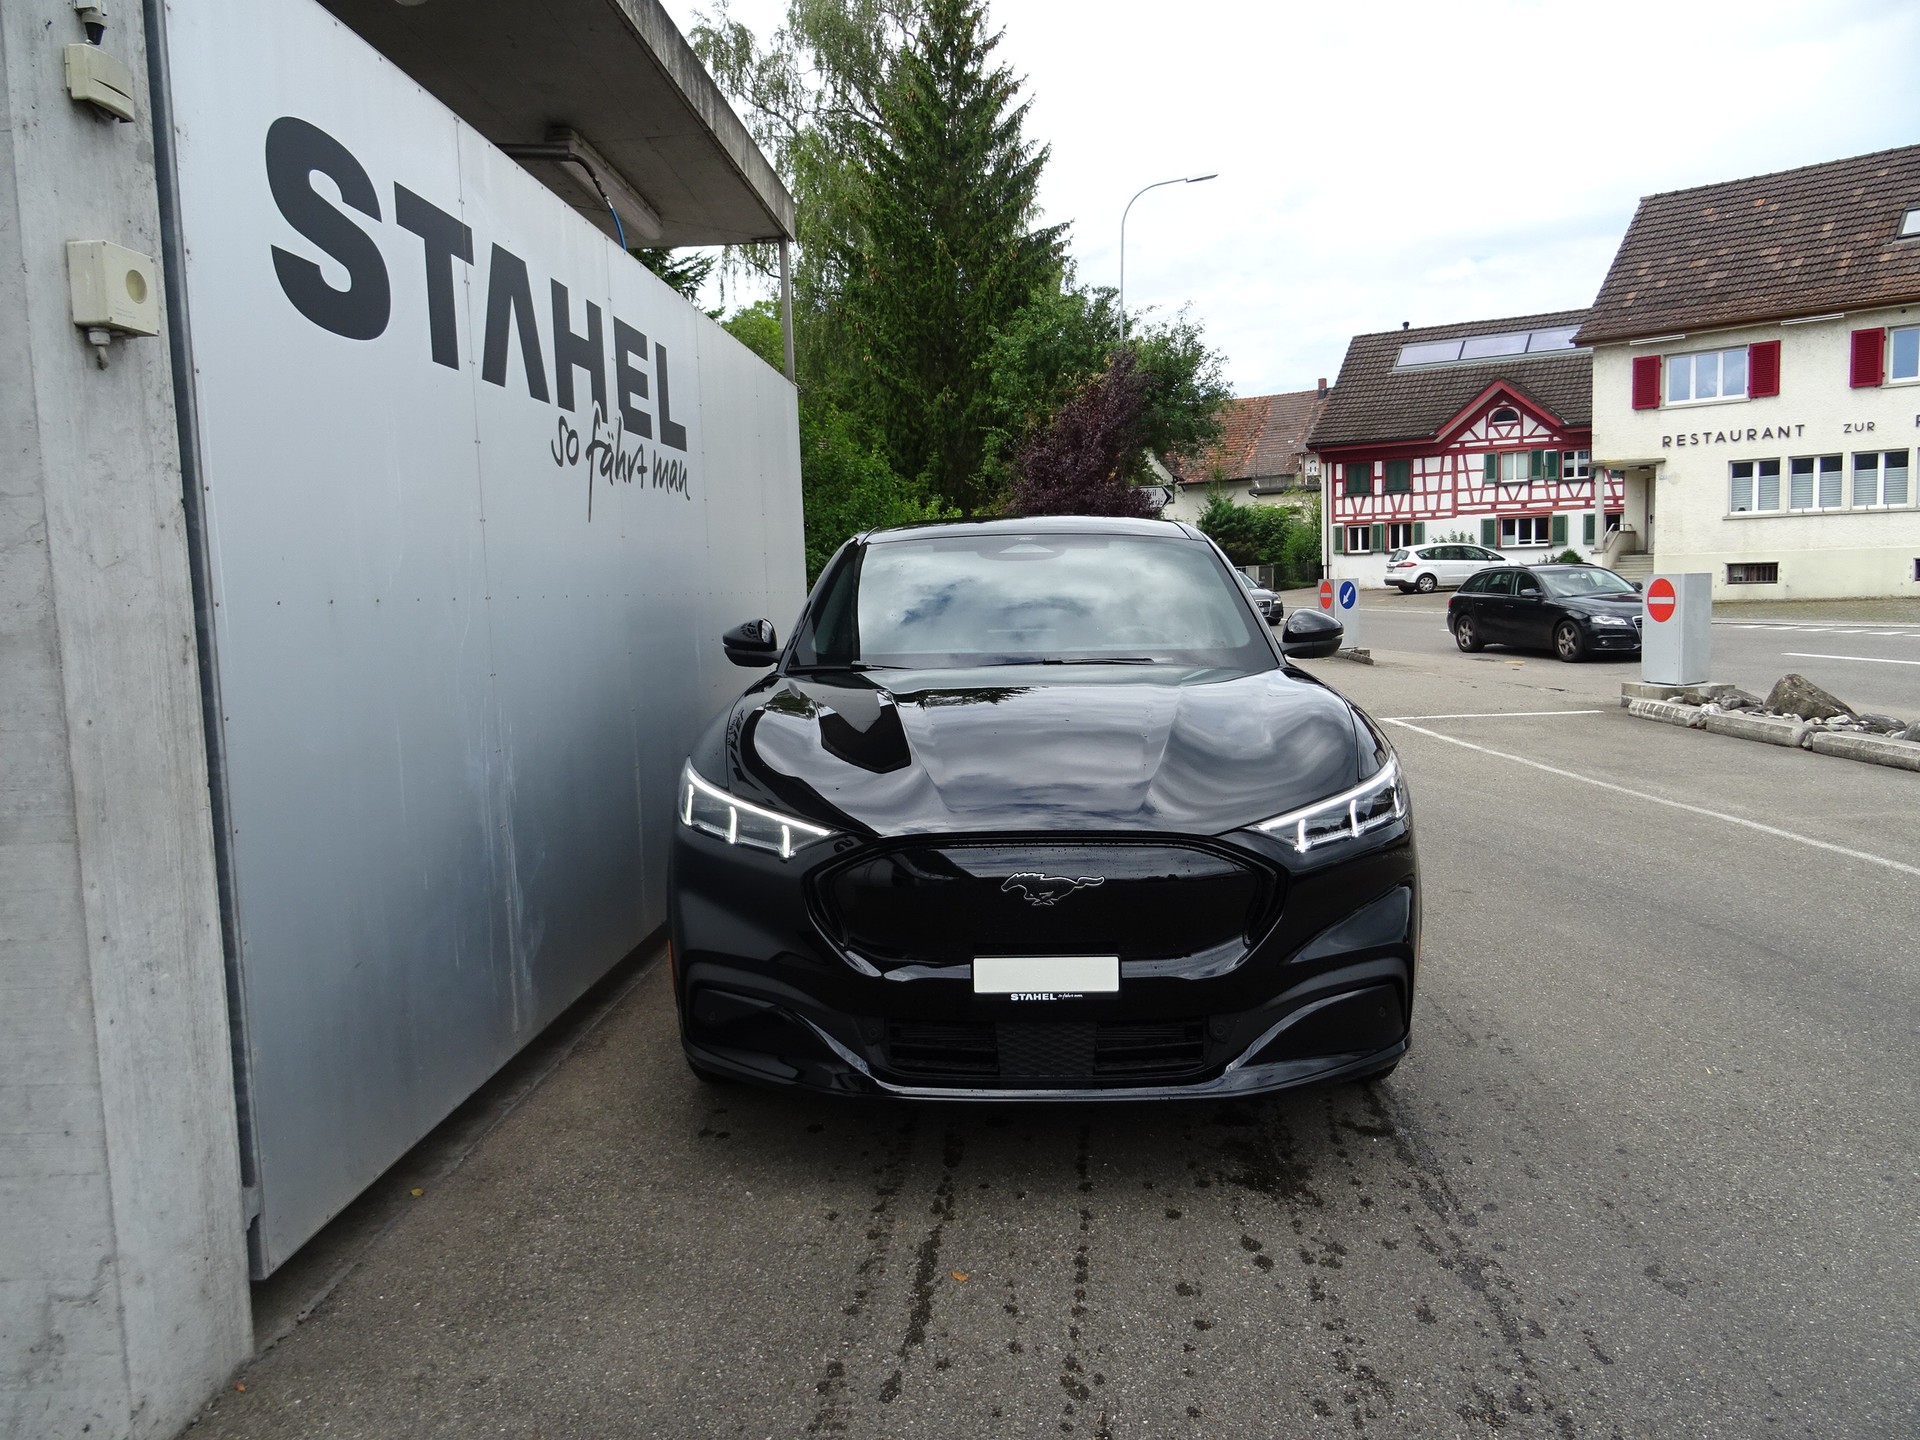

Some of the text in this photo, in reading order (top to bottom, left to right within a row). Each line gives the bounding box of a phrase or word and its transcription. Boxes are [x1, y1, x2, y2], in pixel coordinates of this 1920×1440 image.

[265, 116, 687, 452] STAHEL
[585, 407, 648, 523] fährt
[653, 449, 691, 501] man
[1662, 421, 1876, 448] RESTAURANT ZUR
[1010, 993, 1057, 1001] STAHEL
